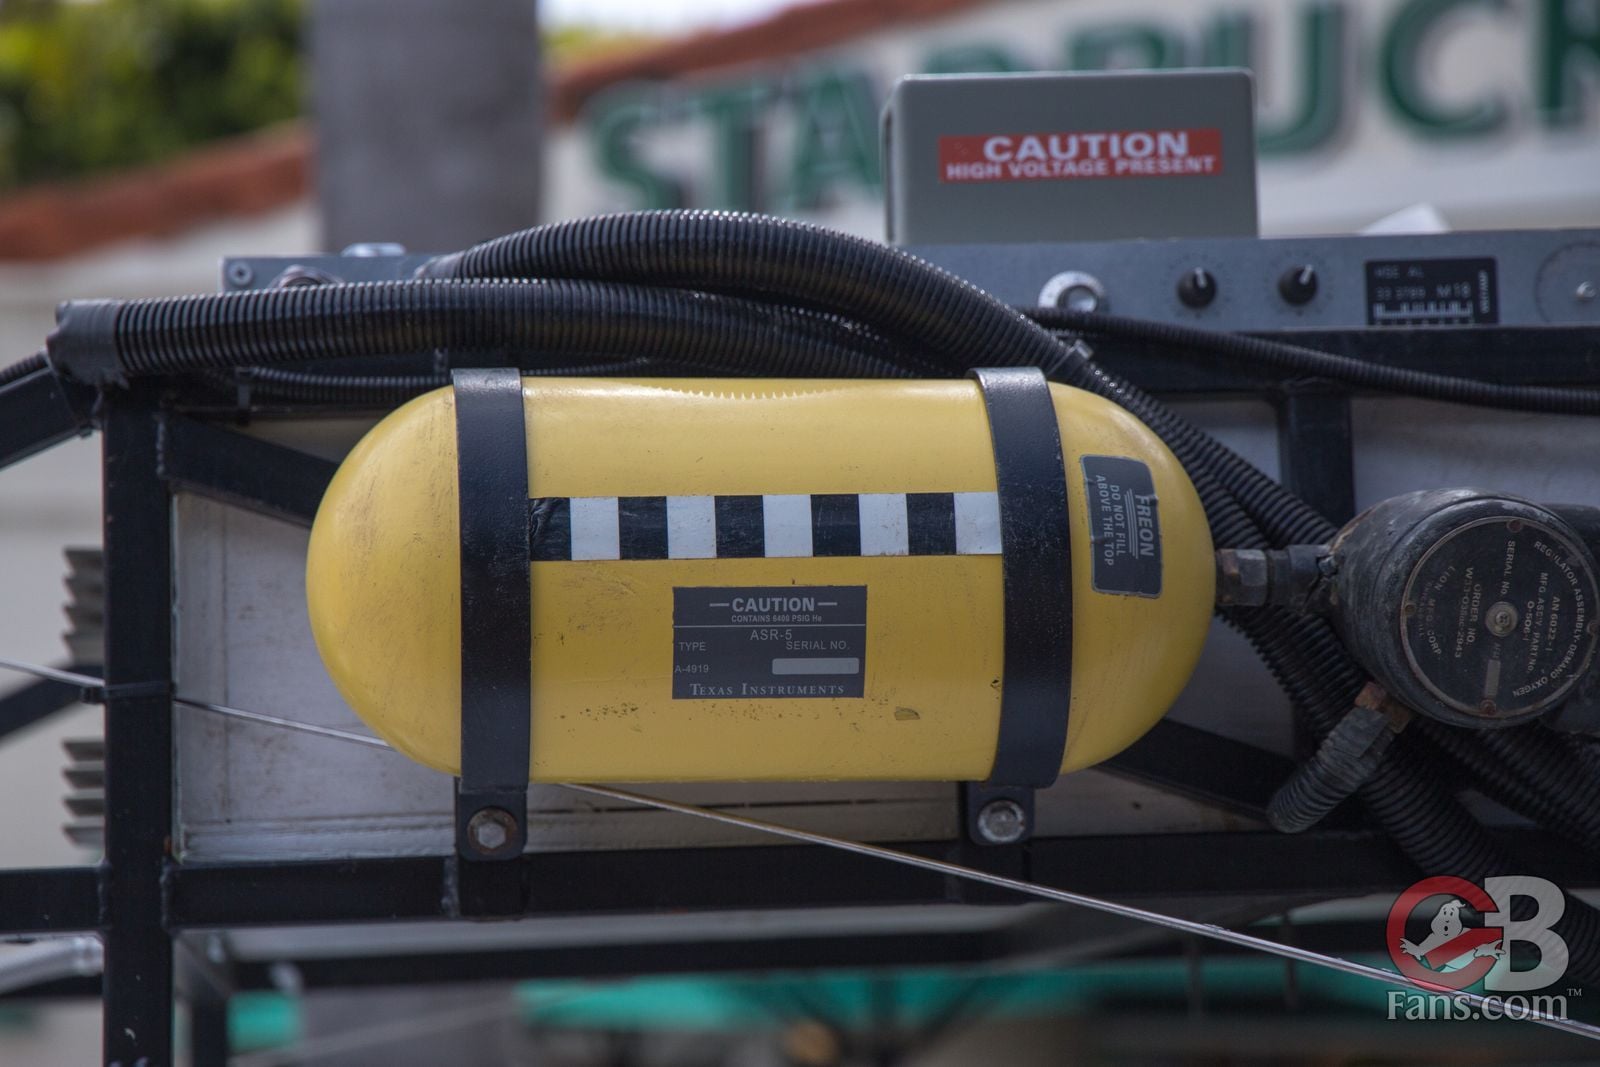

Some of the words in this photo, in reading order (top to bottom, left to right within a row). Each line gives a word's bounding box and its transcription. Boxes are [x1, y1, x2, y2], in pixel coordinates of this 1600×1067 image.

[983, 131, 1189, 162] CAUTION
[946, 161, 1001, 180] HIGH
[1008, 158, 1110, 179] VOLTAGE
[1114, 155, 1216, 175] PRESENT
[1095, 474, 1112, 512] ABOVE
[1109, 484, 1121, 500] DO
[1102, 516, 1114, 539] THE
[1113, 504, 1125, 529] NOT
[1135, 494, 1155, 557] FREON
[1104, 543, 1115, 566] TOP
[1115, 532, 1126, 557] FILL
[1503, 540, 1516, 578] SERIAL
[731, 597, 815, 613] CAUTION
[1468, 583, 1482, 623] ORDER
[1551, 595, 1561, 612] AN
[731, 615, 771, 623] CONTAINS
[772, 614, 790, 623] 6400
[791, 614, 810, 622] PSIG
[812, 614, 823, 622] He
[679, 641, 707, 651] TYPE
[785, 640, 827, 650] SERIAL
[829, 640, 850, 650] NO.
[749, 628, 793, 641] ASR-5
[674, 664, 710, 674] A-4919
[1511, 675, 1548, 698] OXYGEN
